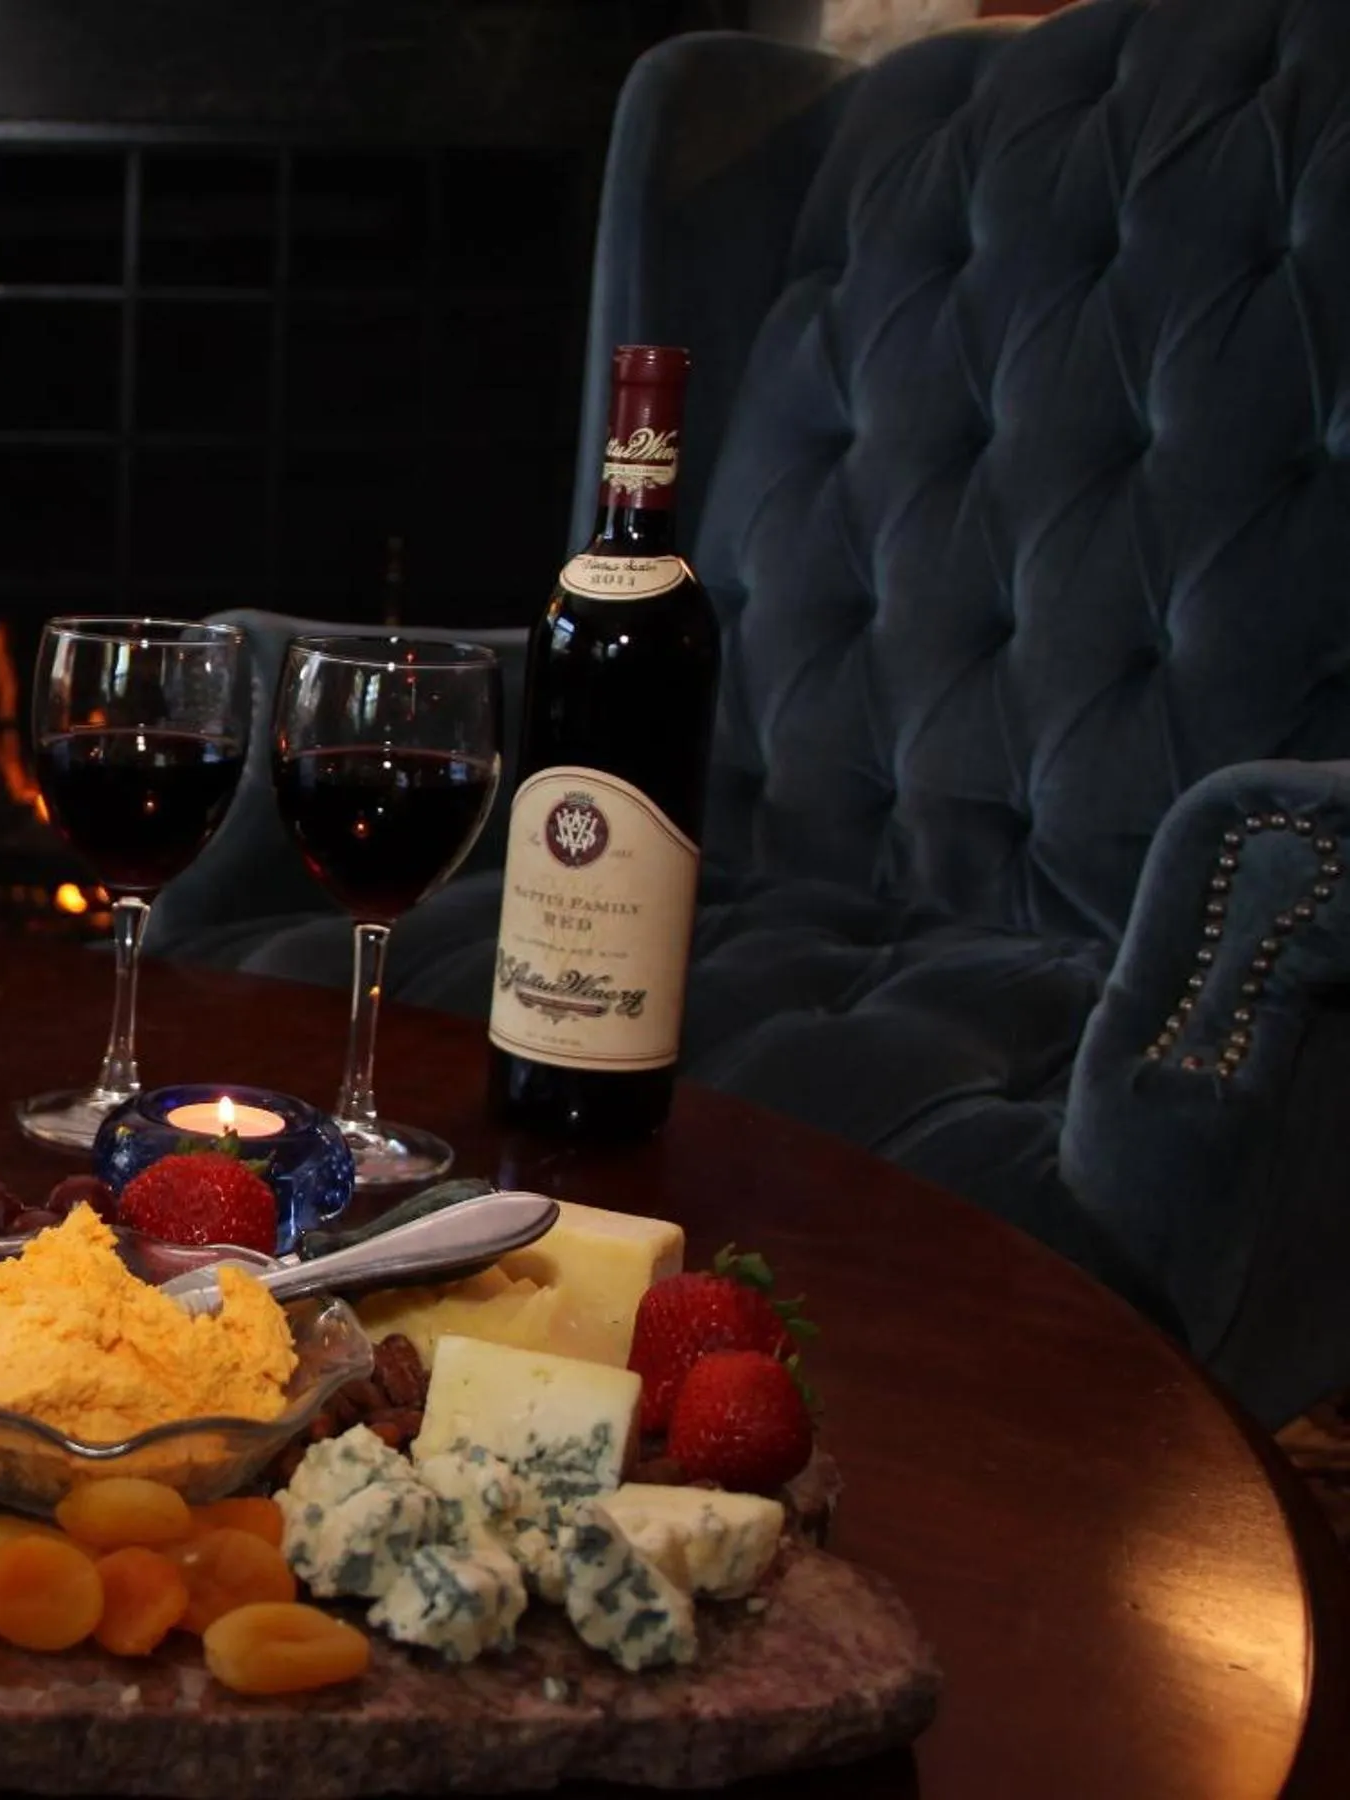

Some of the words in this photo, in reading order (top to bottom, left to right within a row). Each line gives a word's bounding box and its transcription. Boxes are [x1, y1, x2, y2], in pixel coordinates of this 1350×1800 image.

[570, 896, 642, 915] FAMILY
[543, 911, 593, 931] RED
[557, 969, 648, 1019] Winery
